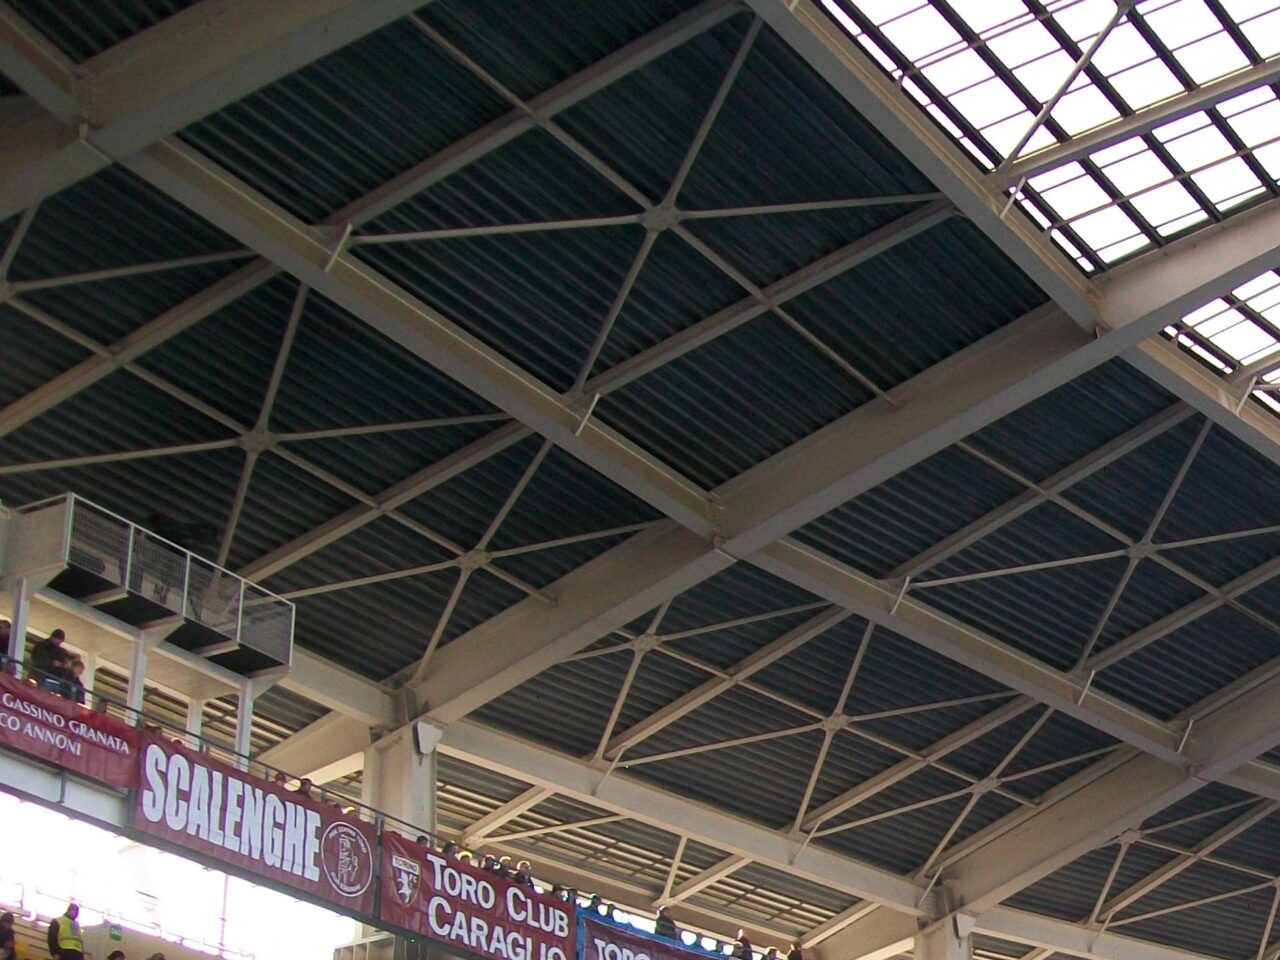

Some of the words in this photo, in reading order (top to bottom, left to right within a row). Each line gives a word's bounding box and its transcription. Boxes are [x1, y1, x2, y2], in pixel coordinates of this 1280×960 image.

[2, 693, 65, 728] GASSINO
[69, 720, 129, 755] GRANATA
[23, 722, 81, 756] ANNONI
[142, 744, 321, 882] SCALENGHE
[427, 853, 495, 909] TORO
[506, 886, 569, 938] CLUB
